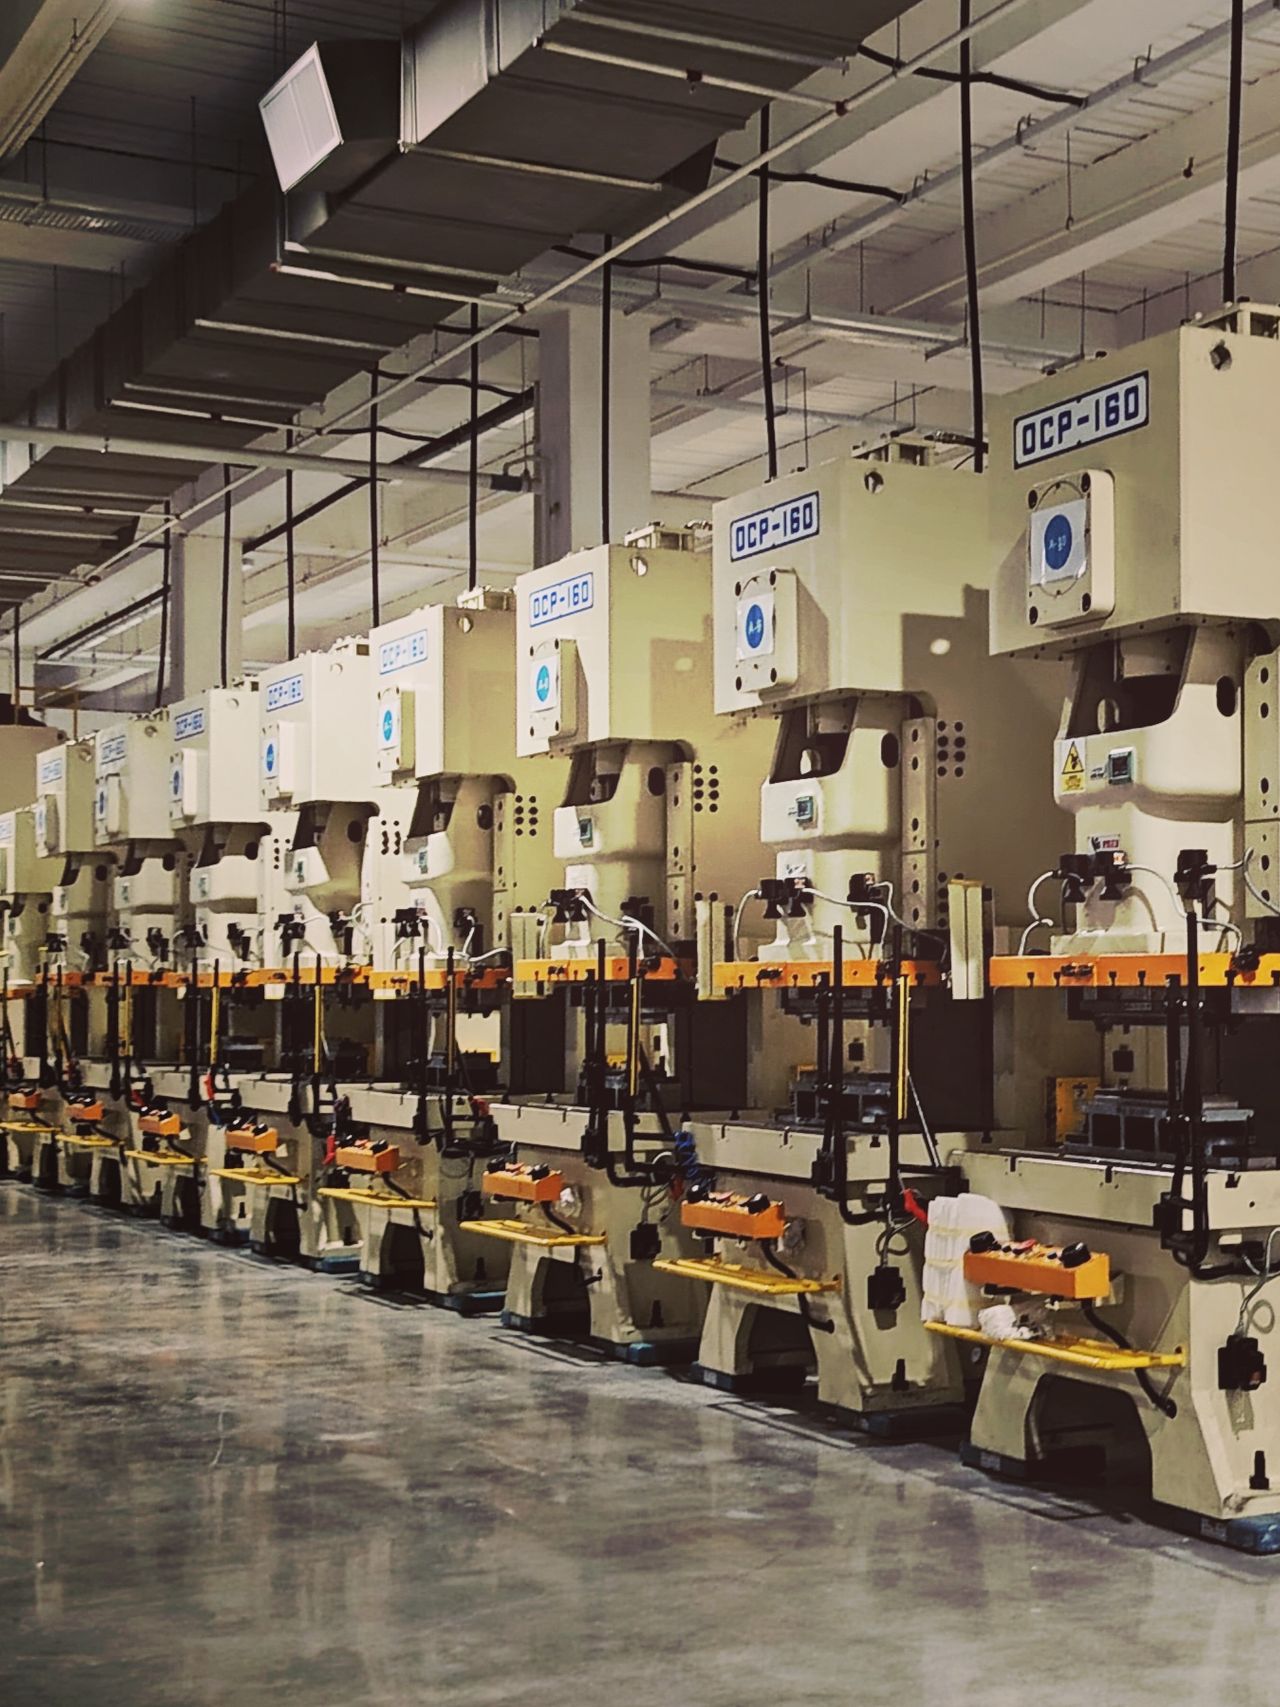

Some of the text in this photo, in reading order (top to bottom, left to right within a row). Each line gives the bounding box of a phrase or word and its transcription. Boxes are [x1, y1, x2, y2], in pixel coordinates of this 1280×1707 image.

[1022, 385, 1140, 456] OCP-160
[736, 502, 813, 552] OCP-160
[533, 580, 589, 619] OCP-160
[382, 635, 425, 668] OCP-60
